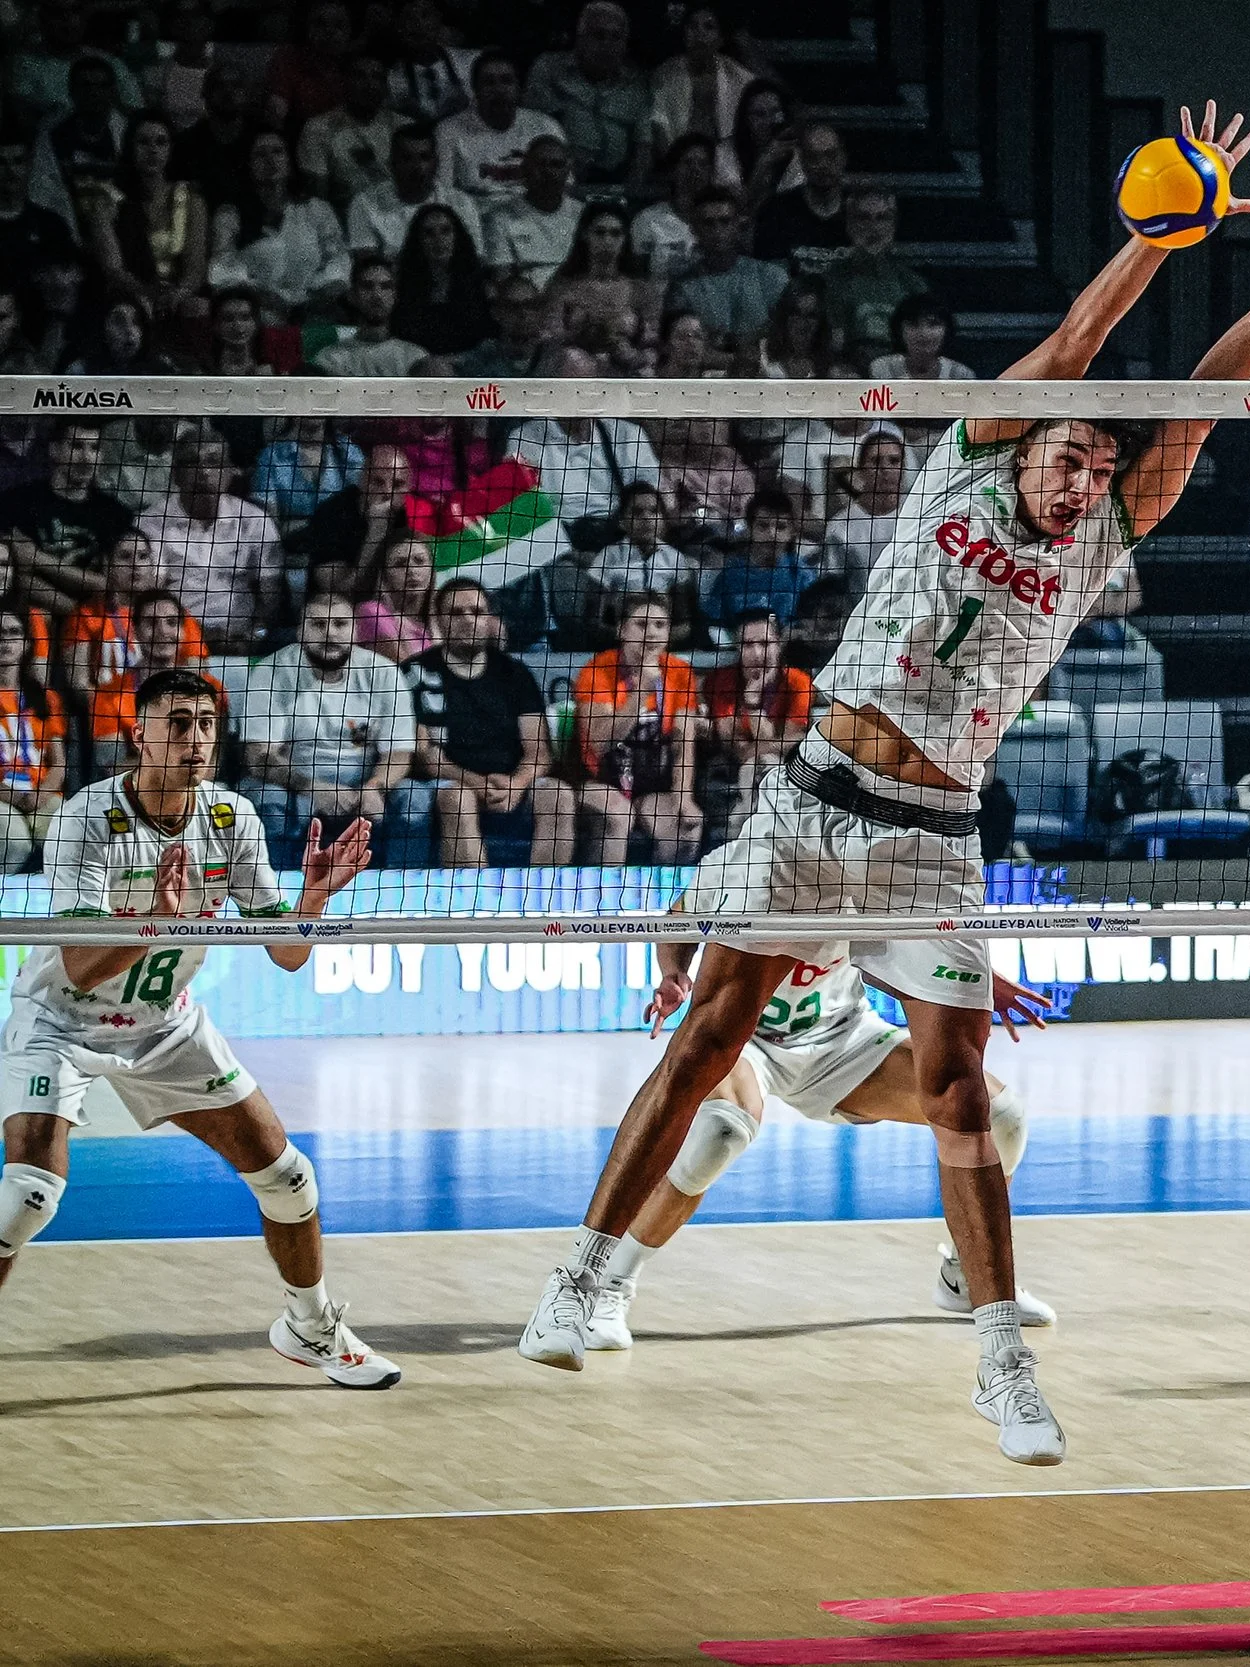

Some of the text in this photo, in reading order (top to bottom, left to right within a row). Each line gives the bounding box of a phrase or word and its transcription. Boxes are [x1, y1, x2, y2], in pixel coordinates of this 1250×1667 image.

[32, 384, 134, 409] MIKASA
[466, 383, 506, 411] VNL
[860, 385, 898, 411] VNL
[168, 924, 258, 936] VOLLEYBALL
[315, 922, 353, 931] Volleyball
[543, 921, 661, 936] VNL VOLLEYBALL
[714, 921, 752, 930] Volleyball
[936, 917, 1051, 931] VNL VOLLEYBALL
[1104, 918, 1141, 926] Volleyball
[314, 912, 426, 994] BUY
[457, 912, 601, 993] YOUR
[120, 948, 183, 1004] 18
[29, 1075, 51, 1097] 18
